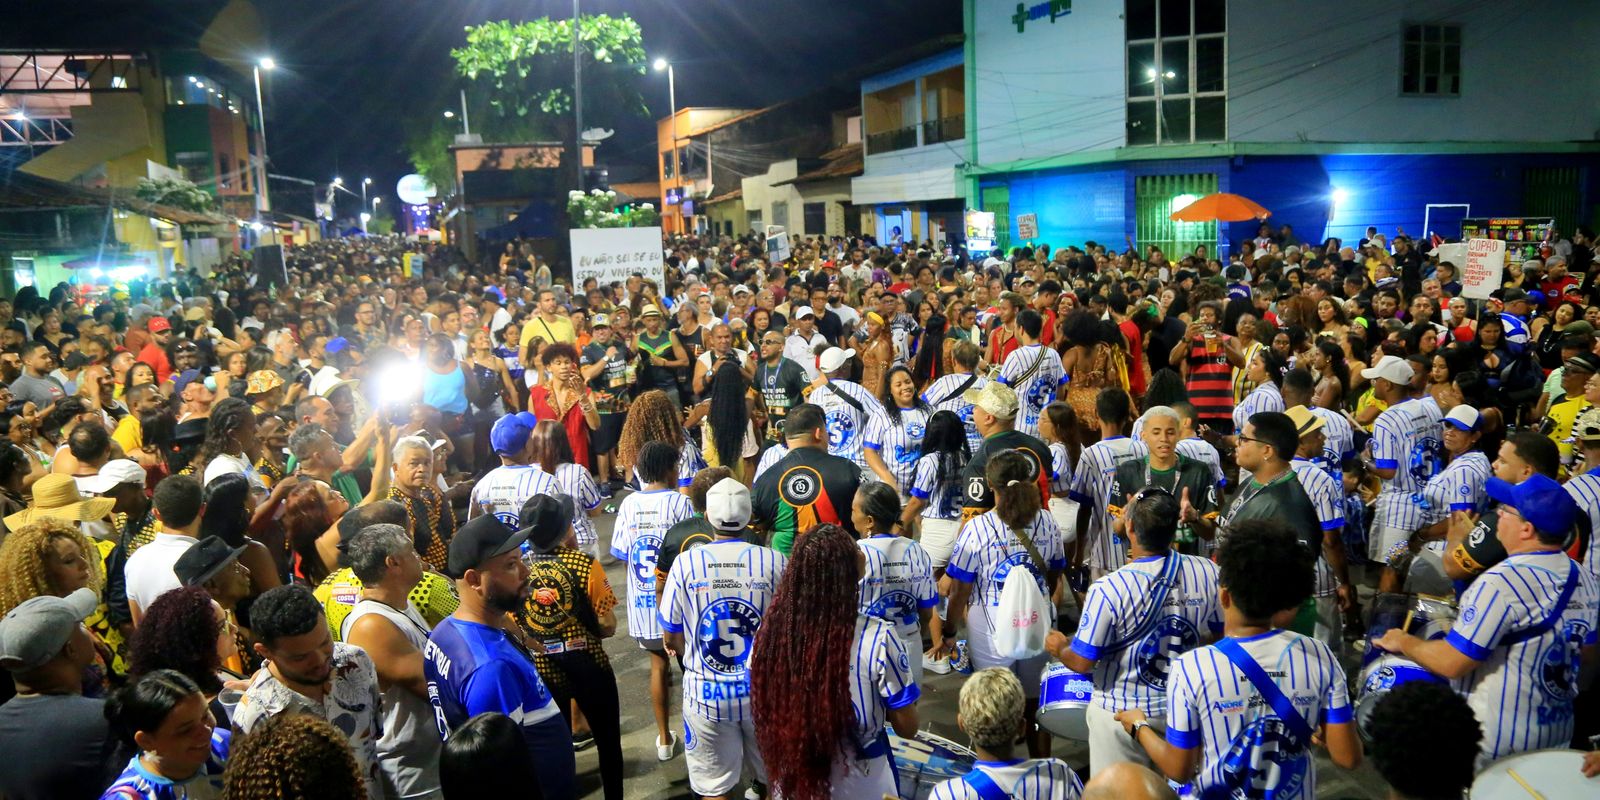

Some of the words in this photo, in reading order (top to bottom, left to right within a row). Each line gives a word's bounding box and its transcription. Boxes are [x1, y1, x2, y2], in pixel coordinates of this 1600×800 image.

[579, 256, 592, 267] EU
[593, 253, 613, 265] NÃO
[617, 253, 630, 263] SEI
[633, 252, 646, 261] SE
[649, 252, 660, 261] EU
[576, 269, 605, 279] ESTOU
[651, 267, 662, 276] OU
[713, 581, 742, 589] BRANDÃO
[702, 602, 760, 628] BATERIA
